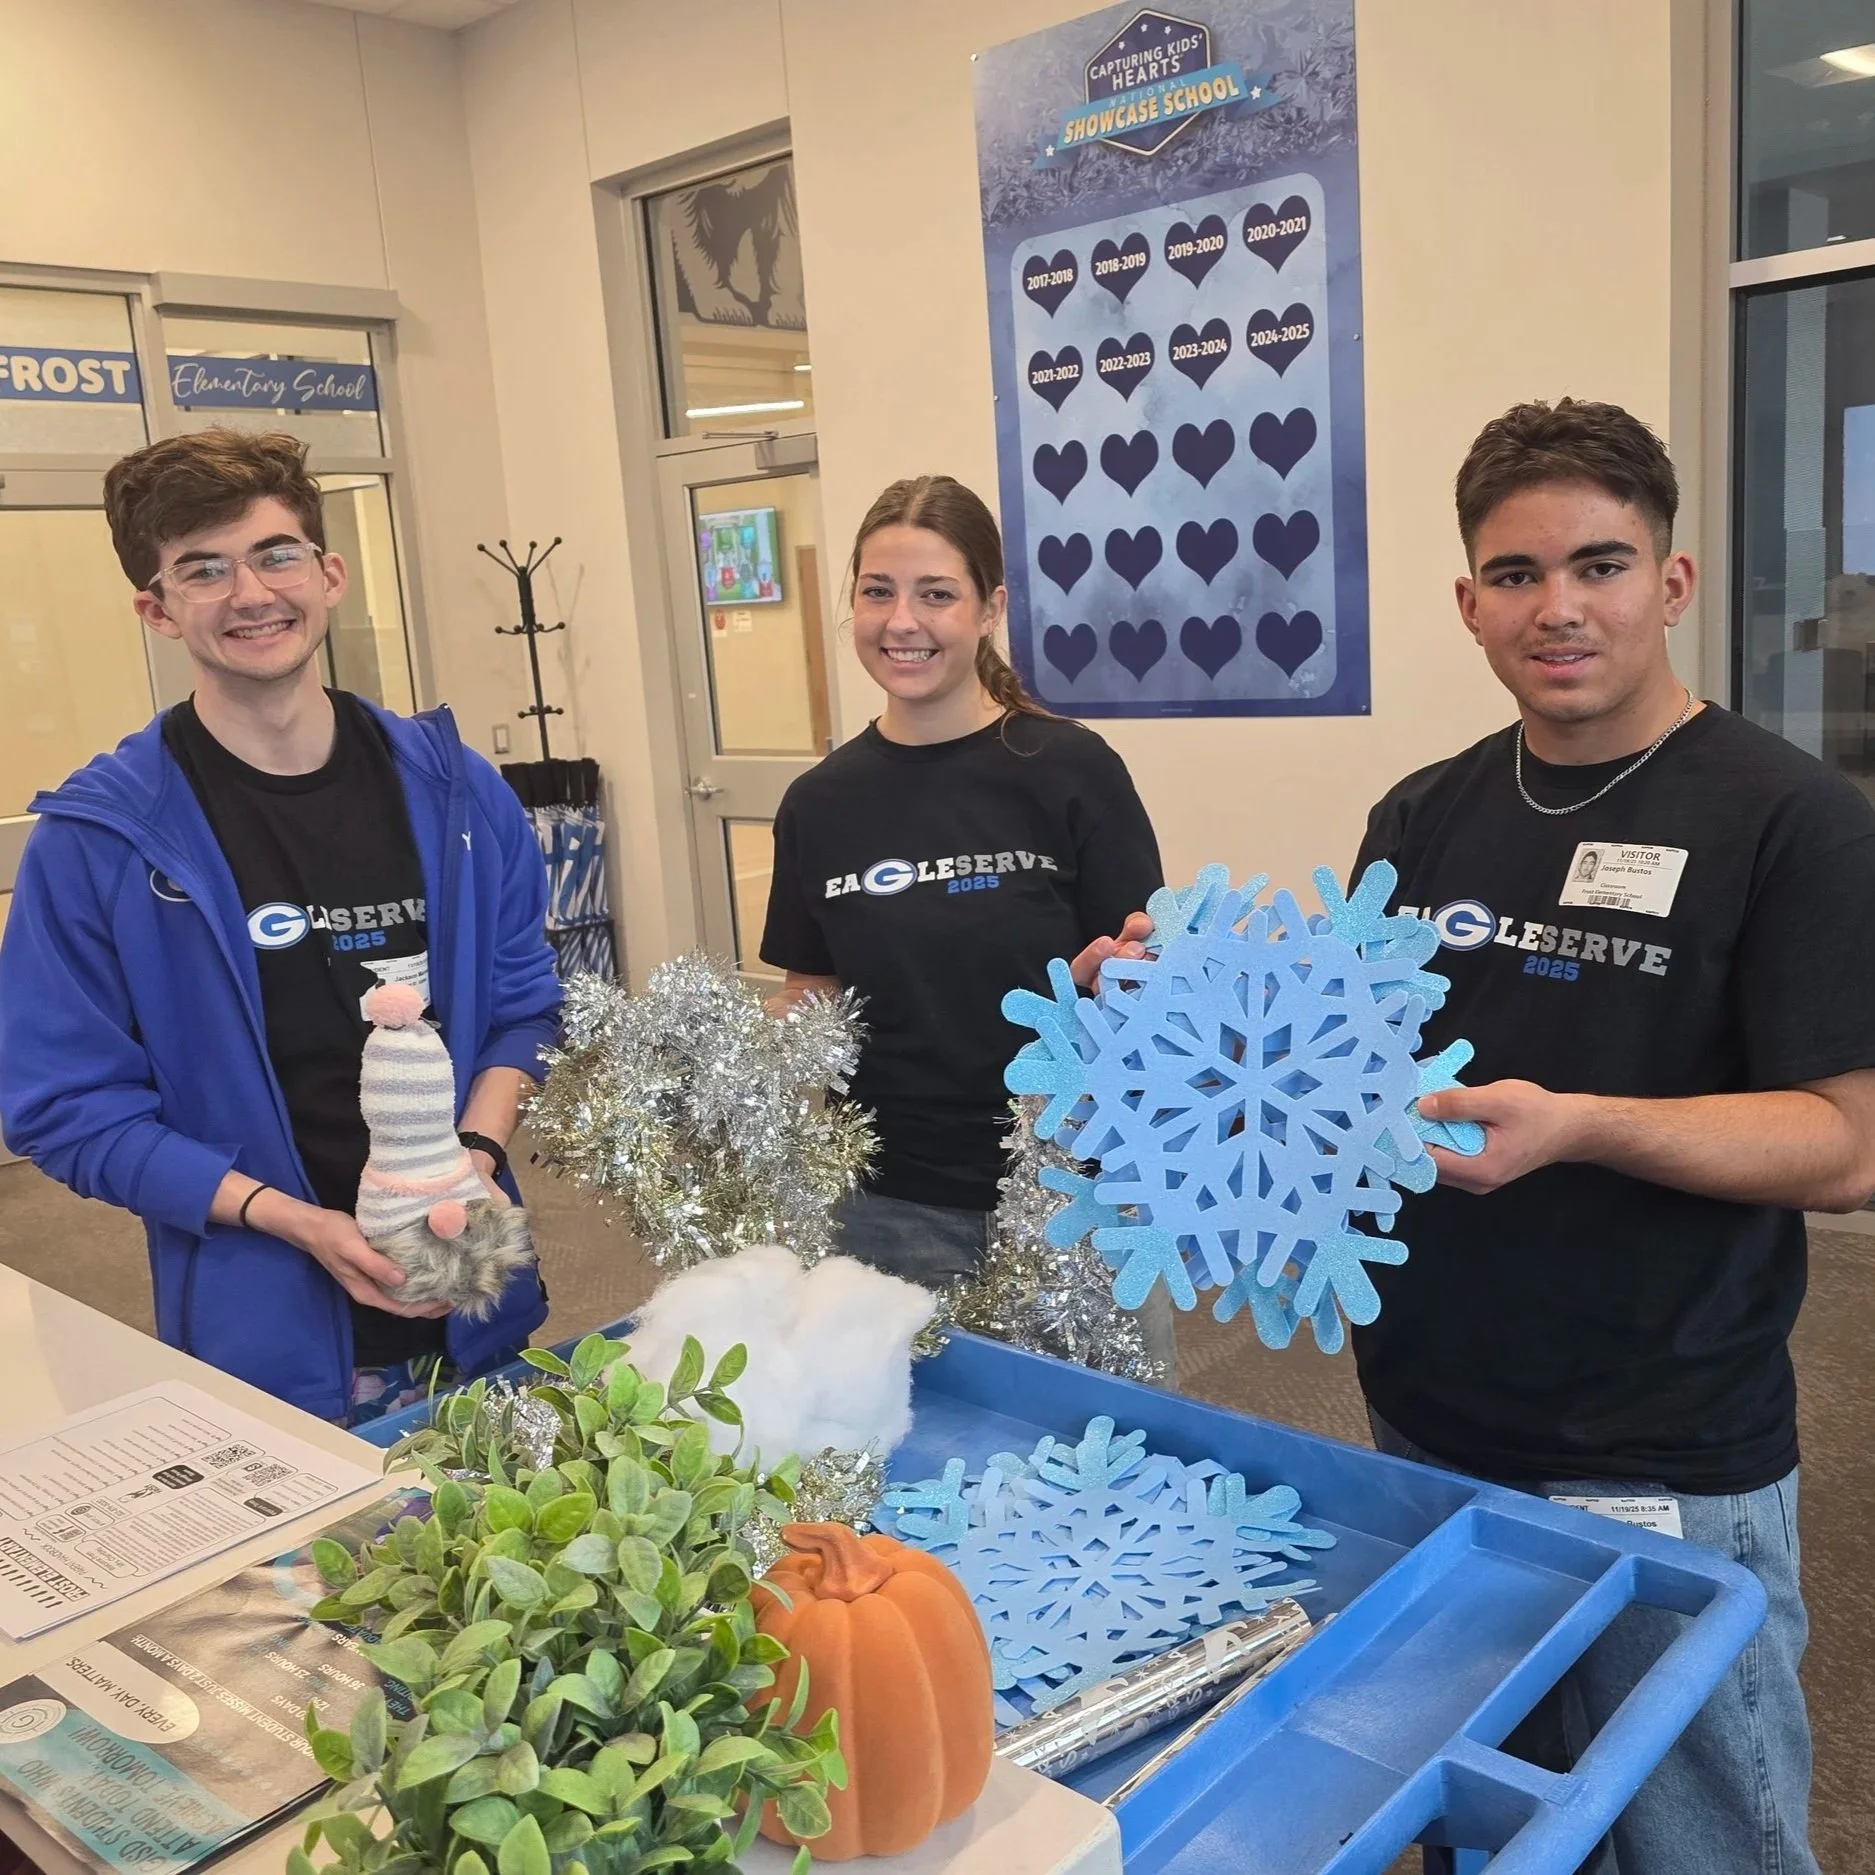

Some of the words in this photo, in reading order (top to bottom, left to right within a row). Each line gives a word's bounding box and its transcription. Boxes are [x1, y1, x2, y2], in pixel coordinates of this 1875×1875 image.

[1090, 47, 1162, 80] CAPTURING
[1109, 79, 1186, 107] NATIONAL
[1064, 97, 1159, 144] SHOWCASE
[1164, 75, 1240, 116] SCHOOL
[1247, 216, 1307, 243] 2020-2021
[1167, 235, 1224, 260] 2019-2020
[1095, 252, 1146, 275] 2018-2019
[1027, 268, 1073, 290] 2017-2018
[1250, 323, 1310, 347] 2024-2025
[1172, 338, 1228, 360] 2023-2024
[1031, 365, 1079, 384] 2021-2022
[1099, 352, 1151, 373] 2022-2023
[172, 363, 285, 404] Elementary
[293, 369, 366, 402] School
[1621, 850, 1661, 861] VISITOR
[1600, 865, 1625, 873] Joseph
[1627, 867, 1652, 875] Bustos
[948, 876, 1000, 894] 2025
[1398, 899, 1672, 976] GLESERVE
[1523, 955, 1580, 982] 2025
[46, 1575, 89, 1600] FROST
[167, 1658, 194, 1676] DAYS
[263, 1650, 299, 1673] HOURS
[193, 1676, 222, 1694] JUST
[297, 1669, 311, 1679] 23
[317, 1663, 355, 1685] HOURS
[350, 1681, 365, 1691] 36
[215, 1691, 254, 1715] MISSES
[270, 1694, 301, 1714] DAYS
[246, 1712, 295, 1742] STUDENT
[16, 1758, 61, 1790] WHO
[52, 1786, 132, 1845] STUDENTS
[151, 1787, 228, 1836] ACHIEVE
[126, 1805, 201, 1855] ATTEND
